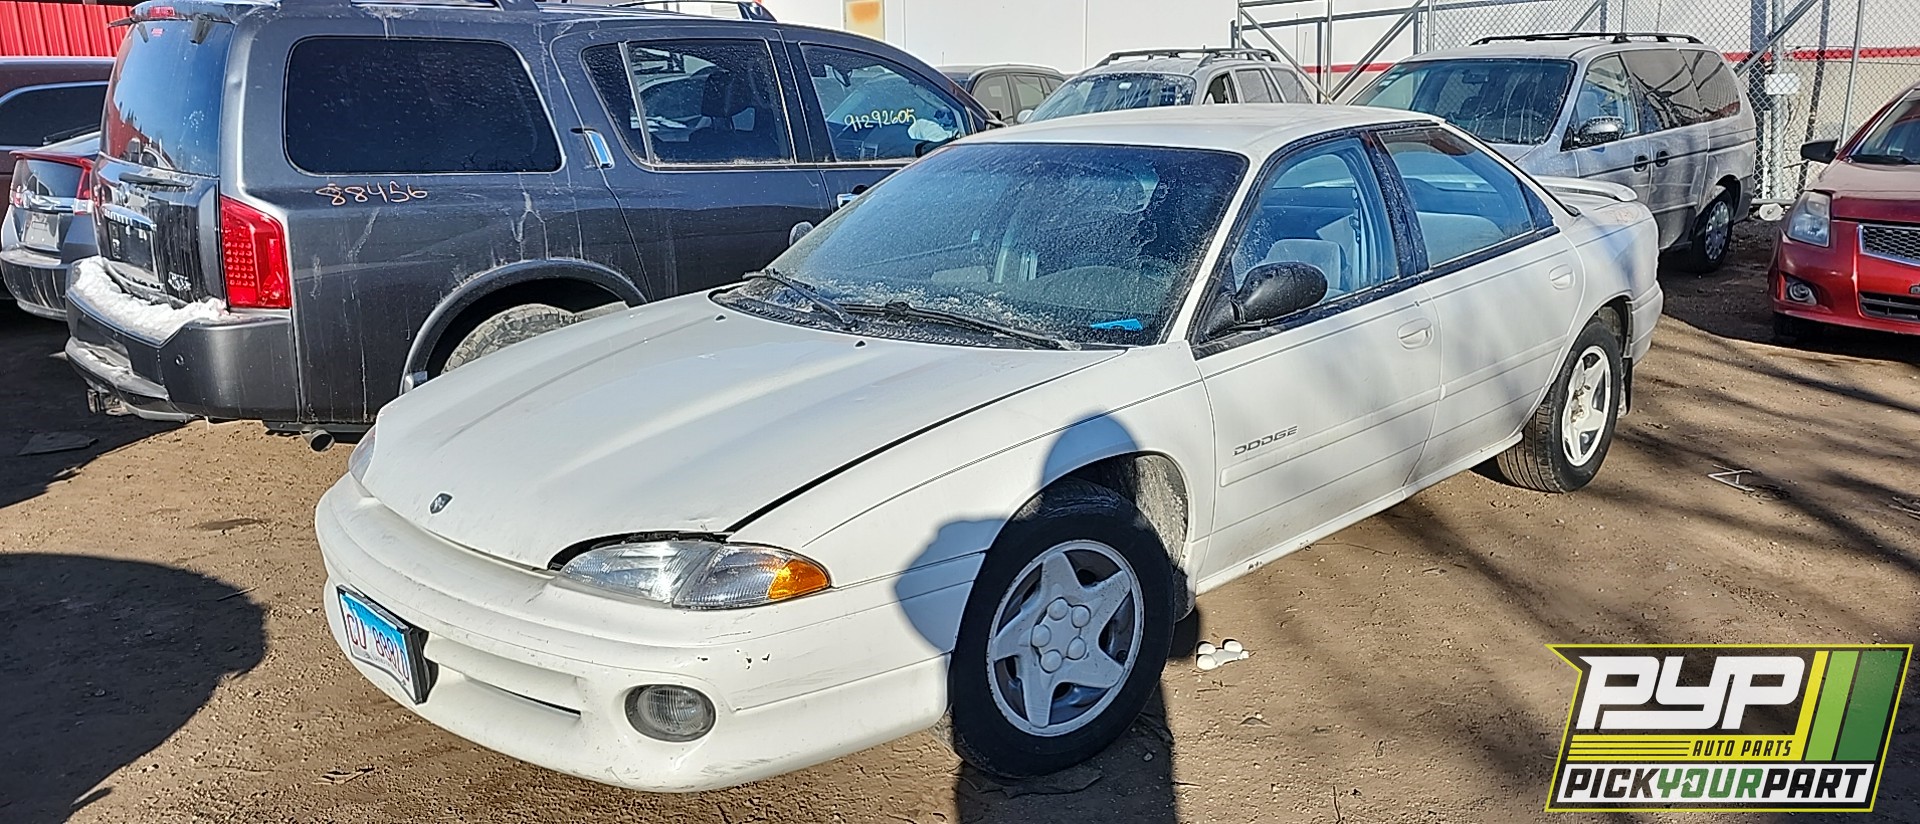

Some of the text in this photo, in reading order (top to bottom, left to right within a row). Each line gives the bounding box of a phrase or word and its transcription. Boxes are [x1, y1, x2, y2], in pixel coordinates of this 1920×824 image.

[844, 108, 917, 132] 91292605
[315, 180, 428, 206] 88456
[1233, 425, 1298, 456] DODGE
[346, 613, 367, 650] CU
